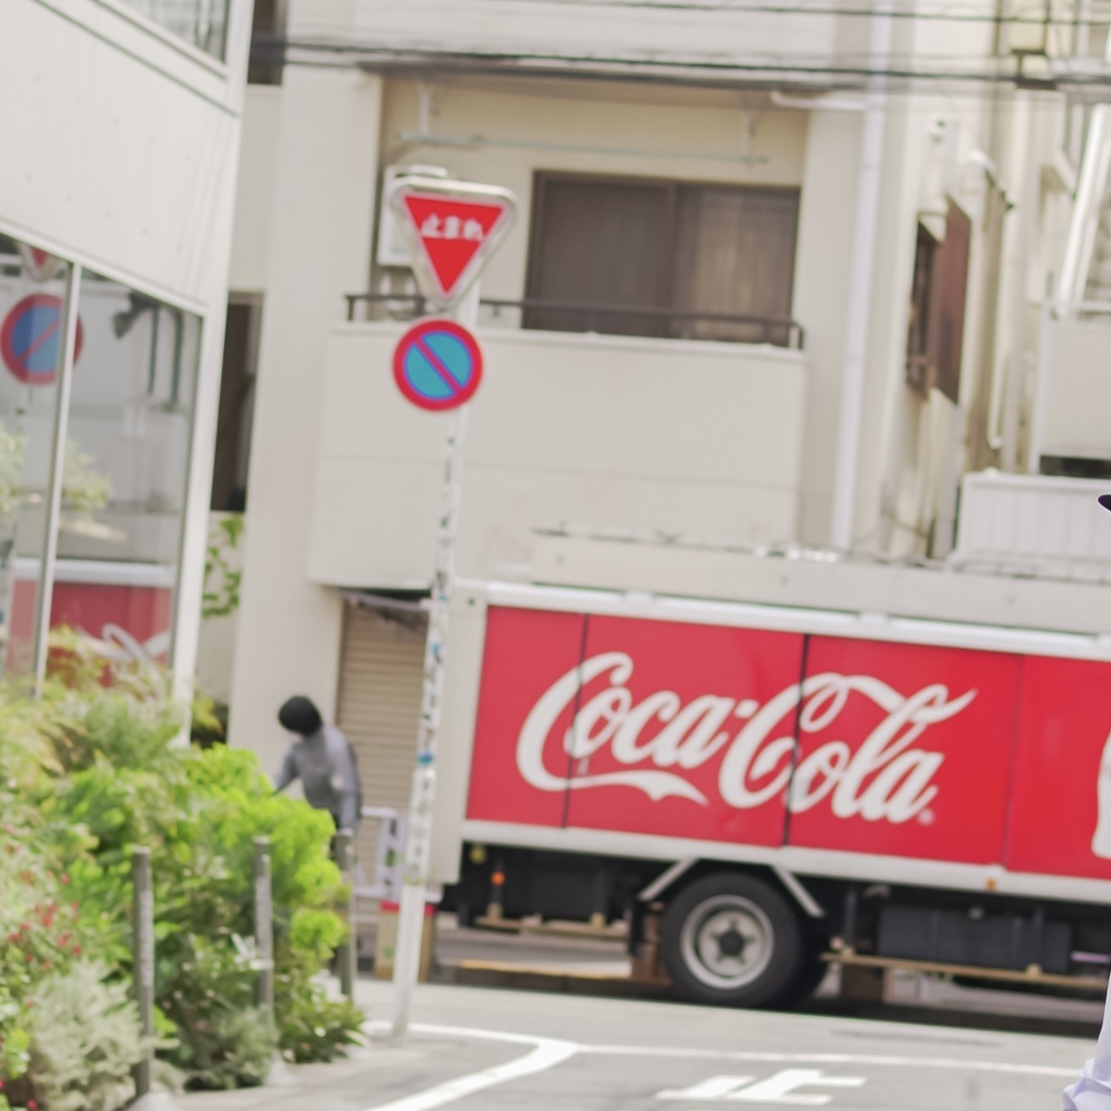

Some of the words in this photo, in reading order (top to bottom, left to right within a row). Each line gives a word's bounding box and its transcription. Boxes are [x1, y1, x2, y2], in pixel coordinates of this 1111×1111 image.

[421, 211, 483, 241] 止まれ
[516, 651, 978, 824] Coca-Cola
